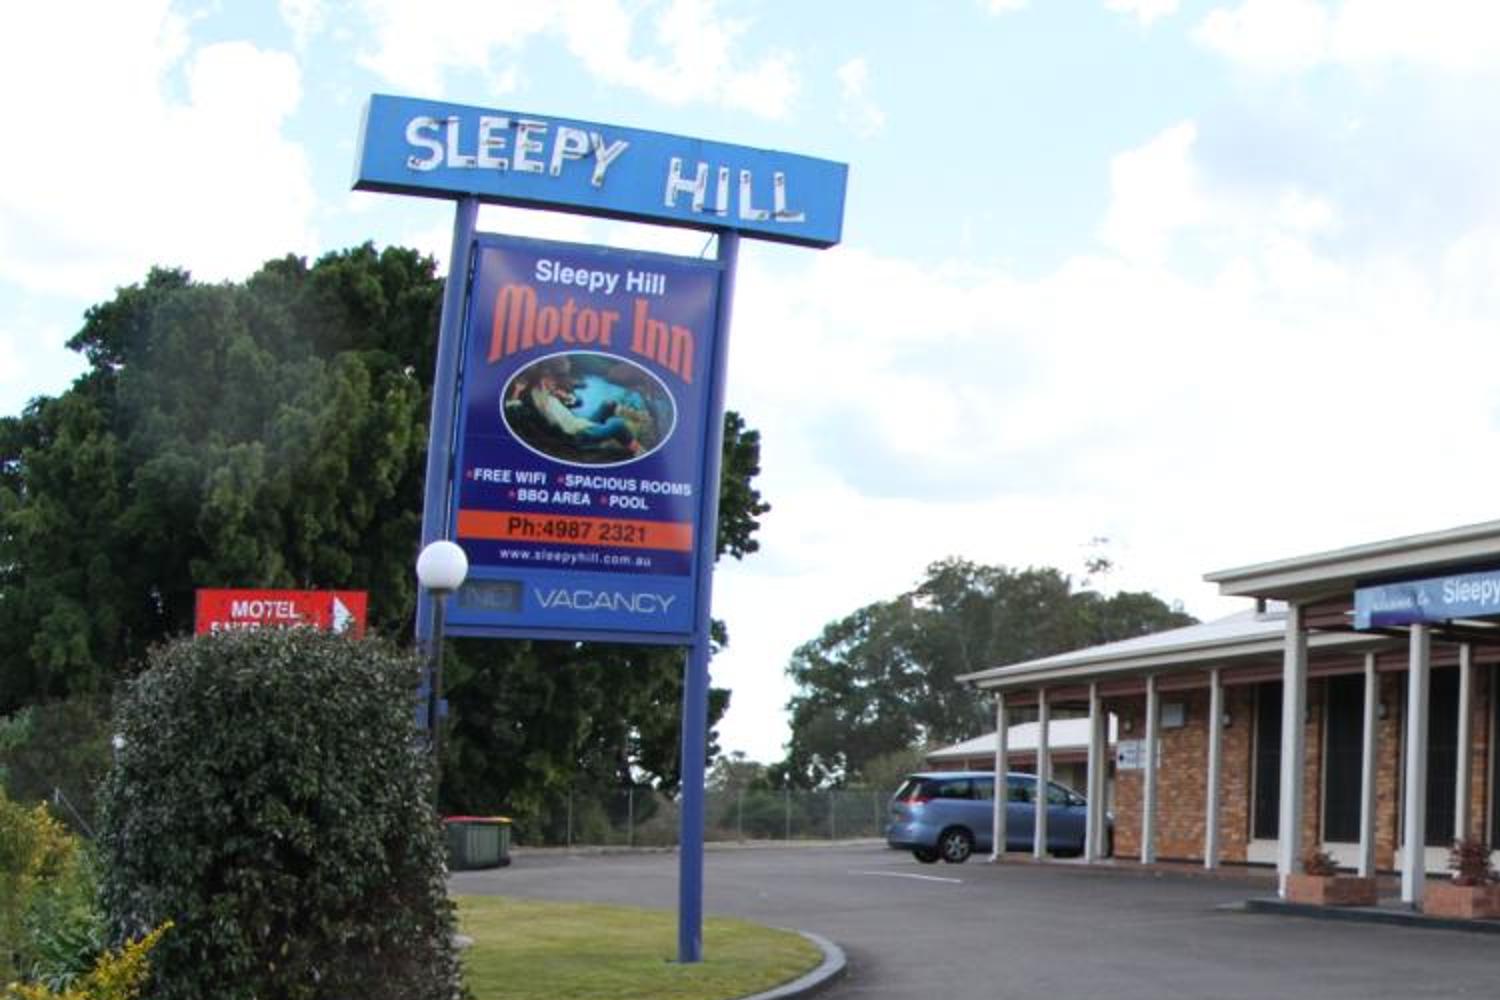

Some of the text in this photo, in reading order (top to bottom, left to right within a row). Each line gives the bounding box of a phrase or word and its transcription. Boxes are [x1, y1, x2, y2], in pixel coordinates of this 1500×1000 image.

[405, 116, 806, 222] SLEEPY HILL
[535, 259, 666, 296] Sleepy Hill
[488, 285, 695, 384] Motor Inn
[473, 468, 691, 496] FREE WIFI SPACIOUS ROOMS
[517, 489, 649, 509] BBQ AREA POOL
[598, 524, 647, 543] 2321
[231, 601, 299, 619] MOTEL
[534, 588, 675, 614] VACANCY
